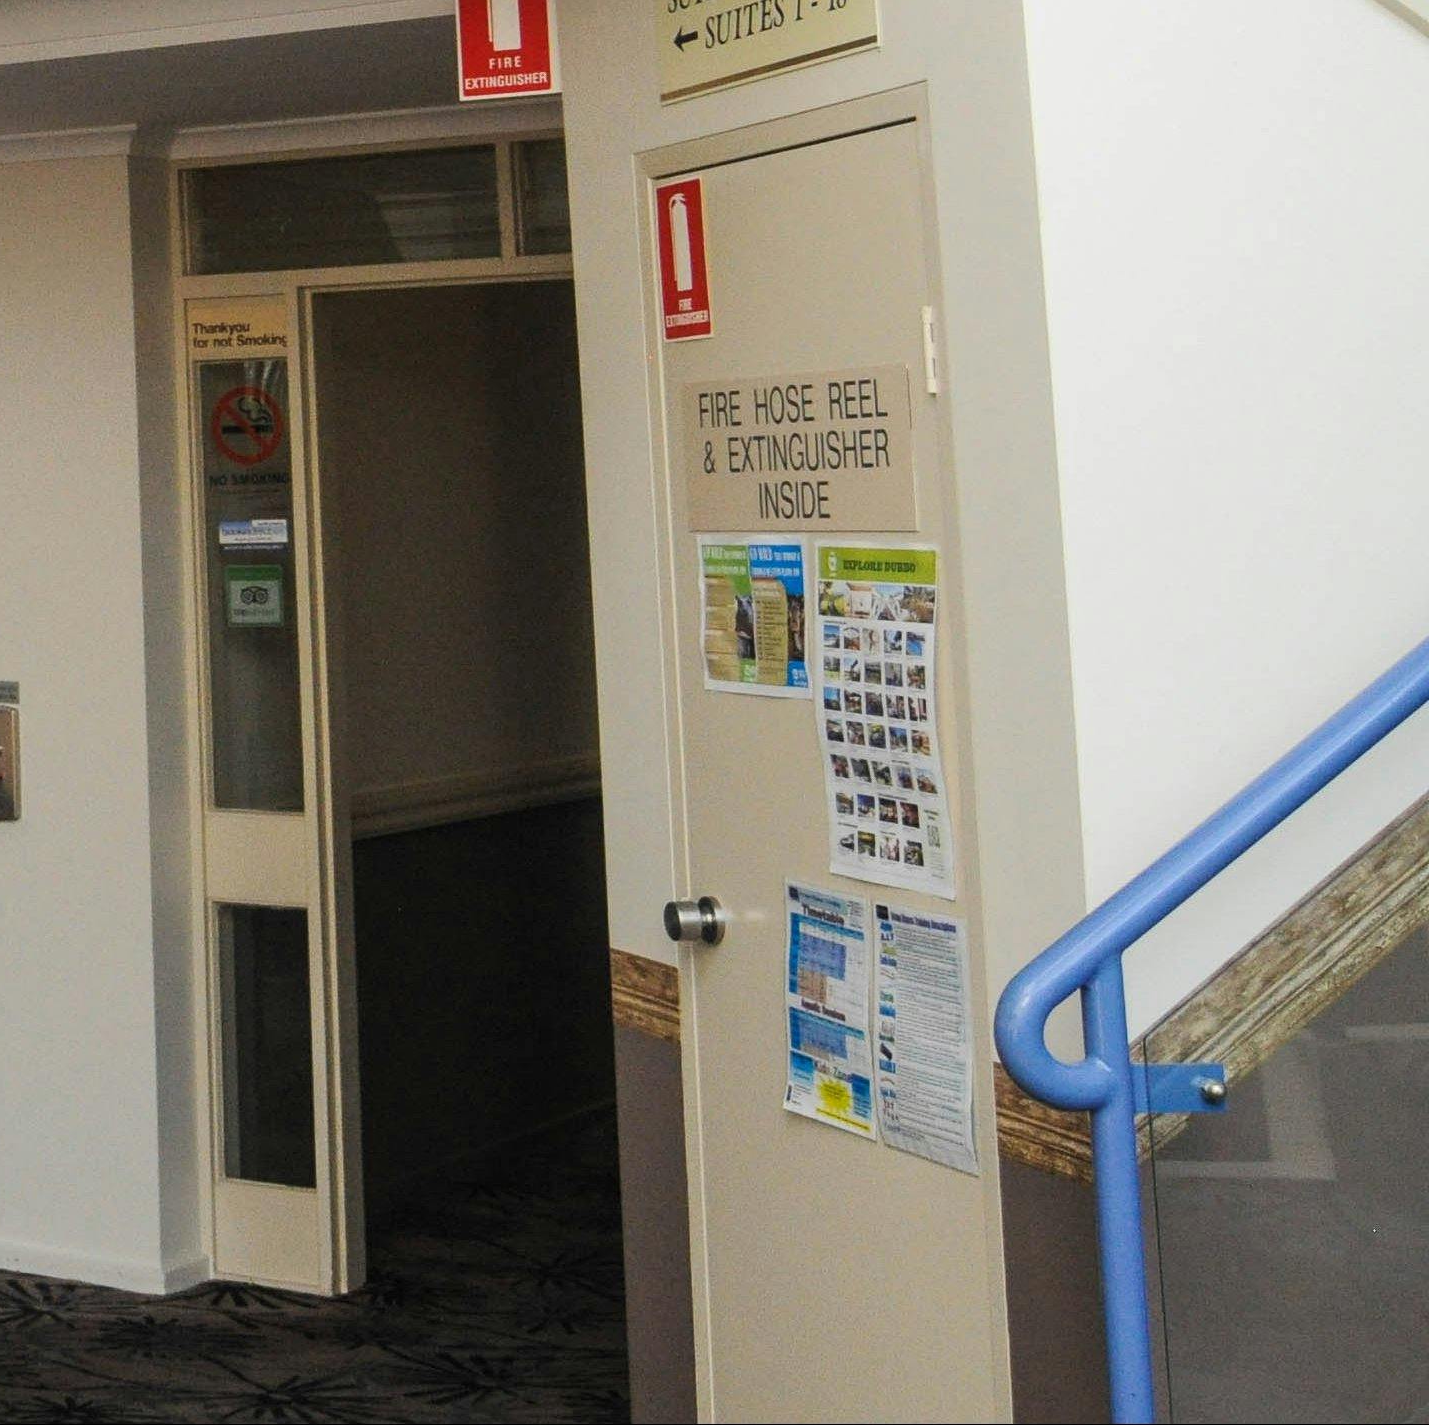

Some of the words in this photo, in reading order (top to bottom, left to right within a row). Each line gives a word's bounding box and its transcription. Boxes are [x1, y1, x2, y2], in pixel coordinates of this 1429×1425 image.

[488, 55, 522, 70] FIRE
[464, 71, 548, 90] EXTINGUISHER
[192, 322, 250, 335] Thankyou
[193, 337, 209, 349] for
[213, 337, 234, 347] not
[236, 333, 287, 348] Smoking
[698, 391, 742, 428] FIRE
[753, 384, 815, 425] HOSE
[828, 378, 888, 420] REEL
[703, 441, 717, 474] &
[727, 428, 891, 473] EXTINGUISHER
[758, 481, 831, 519] INSIDE
[843, 559, 882, 571] EXPLORE
